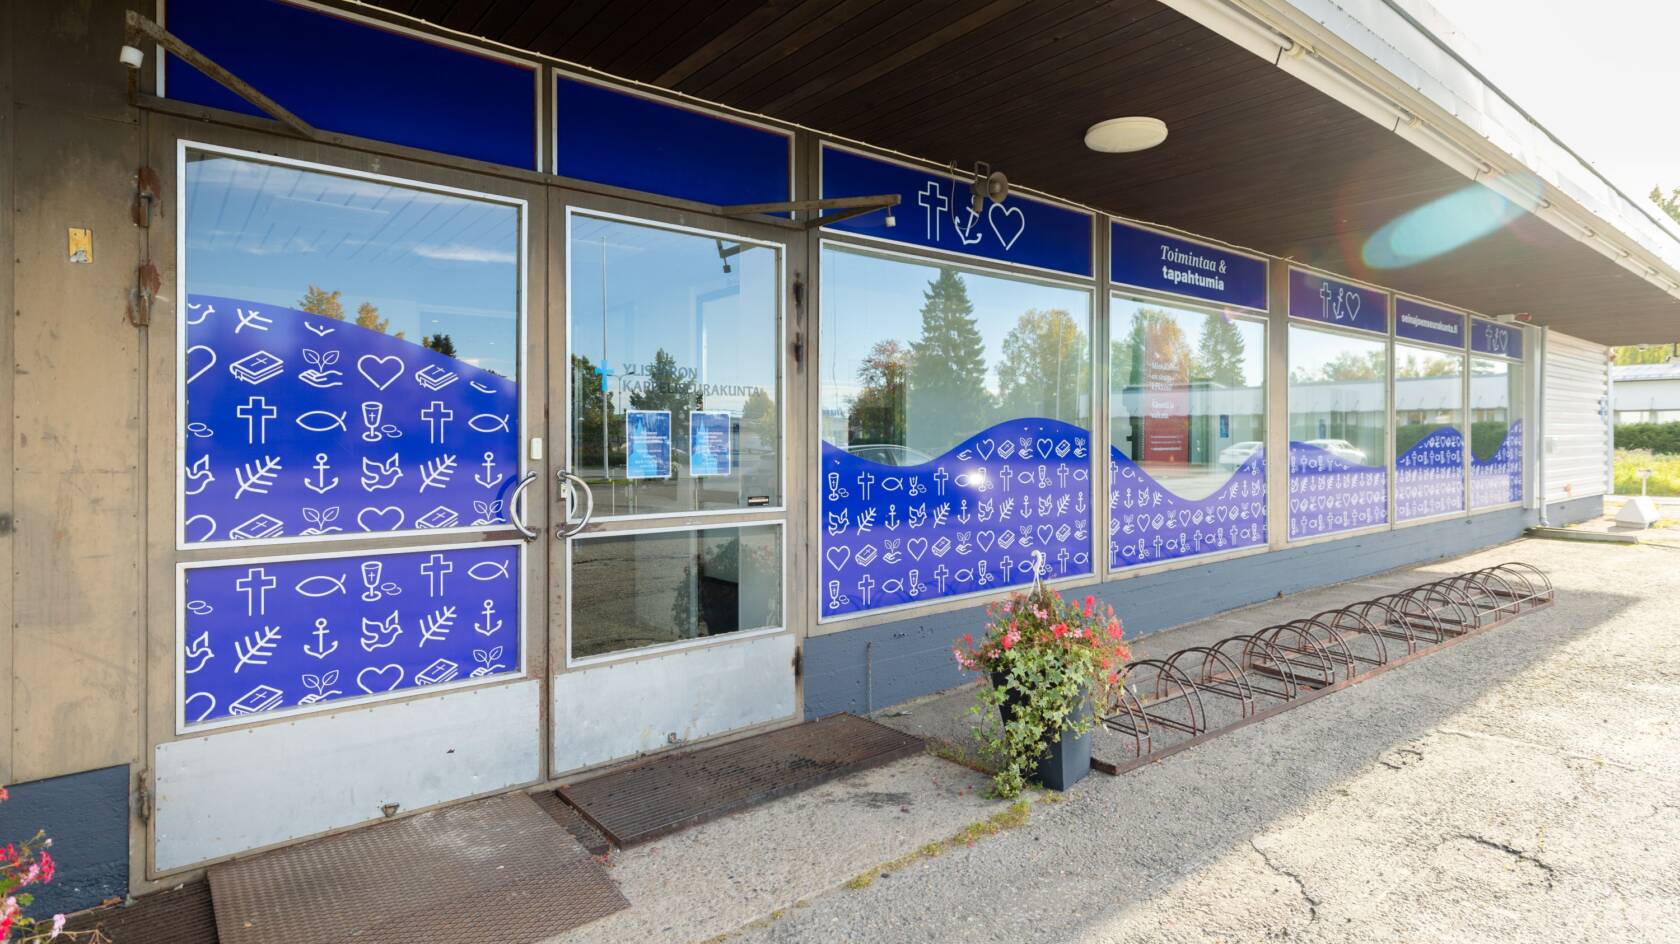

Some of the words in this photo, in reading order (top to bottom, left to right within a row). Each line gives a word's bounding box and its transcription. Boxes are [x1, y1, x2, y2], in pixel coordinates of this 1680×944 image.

[1160, 244, 1217, 272] Toimintaa
[1218, 259, 1227, 274] &
[1162, 265, 1225, 291] tapahtumia
[623, 363, 698, 379] YLISRON
